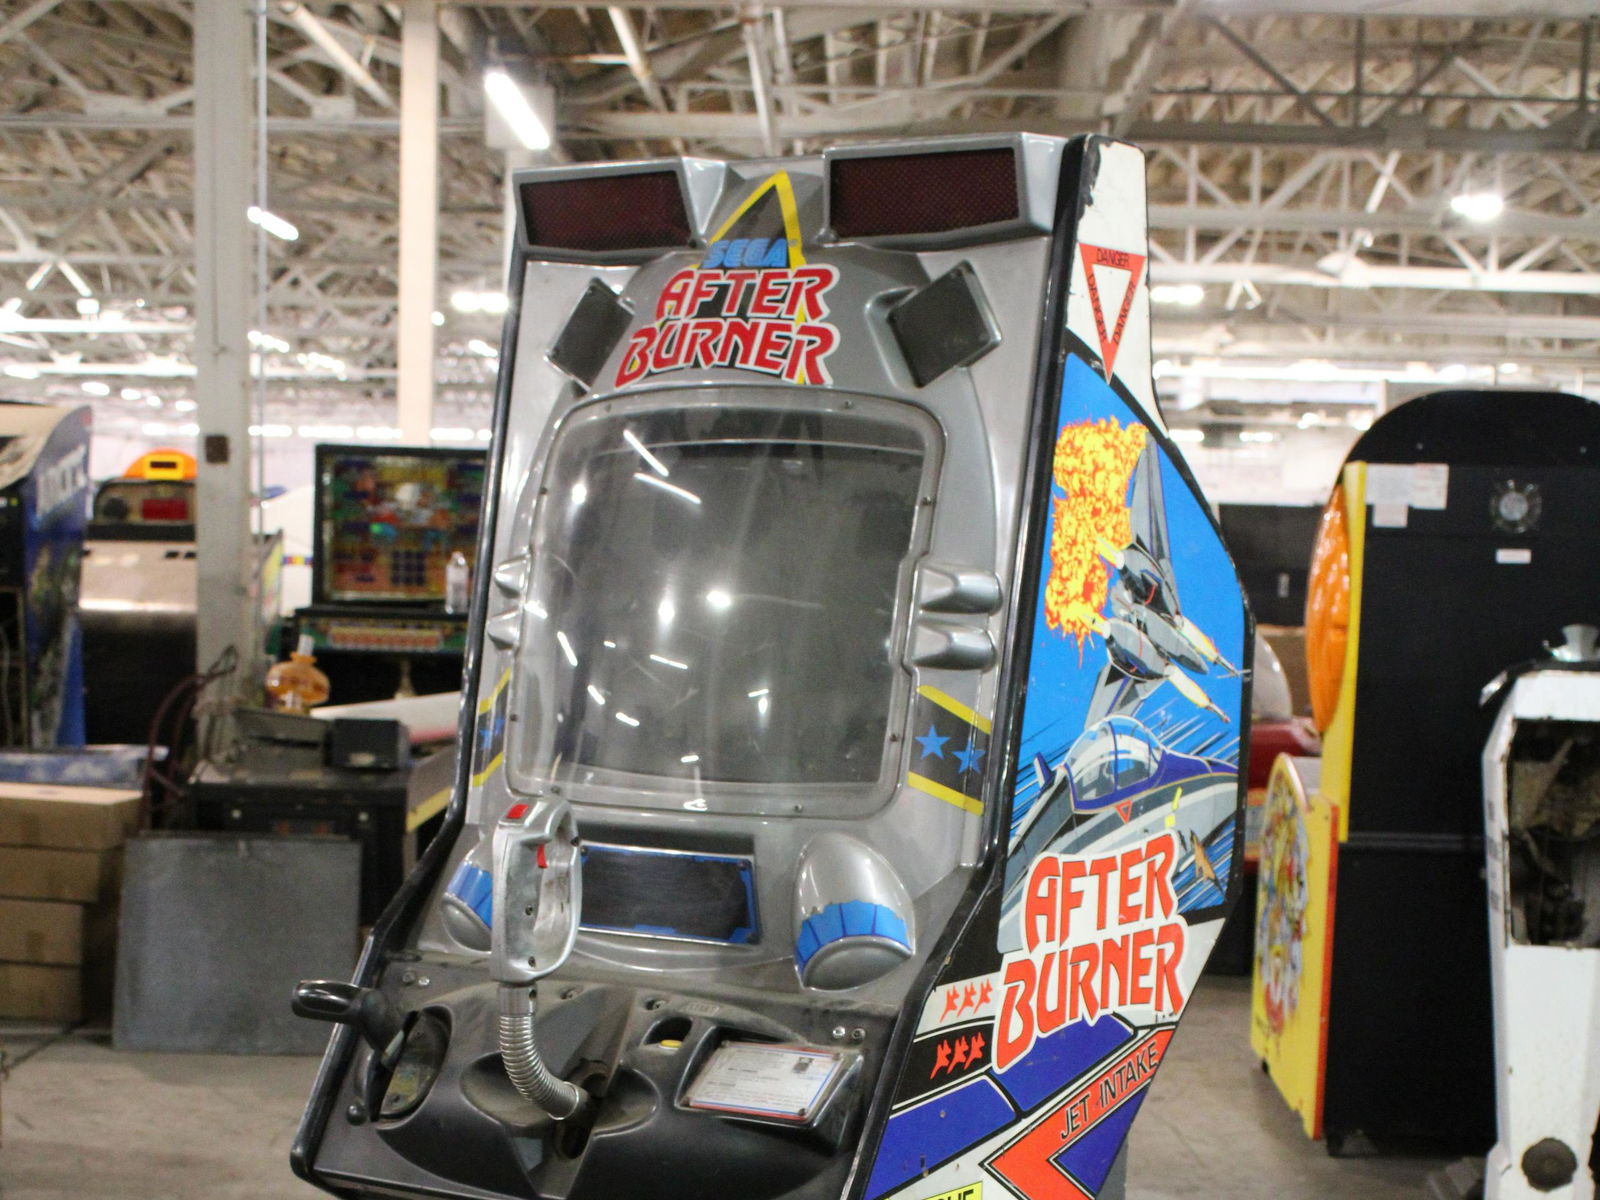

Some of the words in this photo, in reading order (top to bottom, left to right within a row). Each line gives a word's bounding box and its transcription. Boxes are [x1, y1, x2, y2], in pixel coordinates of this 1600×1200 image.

[702, 238, 788, 269] SEGA
[1096, 248, 1131, 267] DANGER
[655, 266, 835, 322] AFTER
[1112, 280, 1136, 345] DANGER
[614, 319, 836, 389] BURNER
[1024, 833, 1175, 954] AFTER
[996, 922, 1185, 1069] BURNER
[1061, 1092, 1091, 1140] JET
[1100, 1041, 1159, 1109] INTAKE
